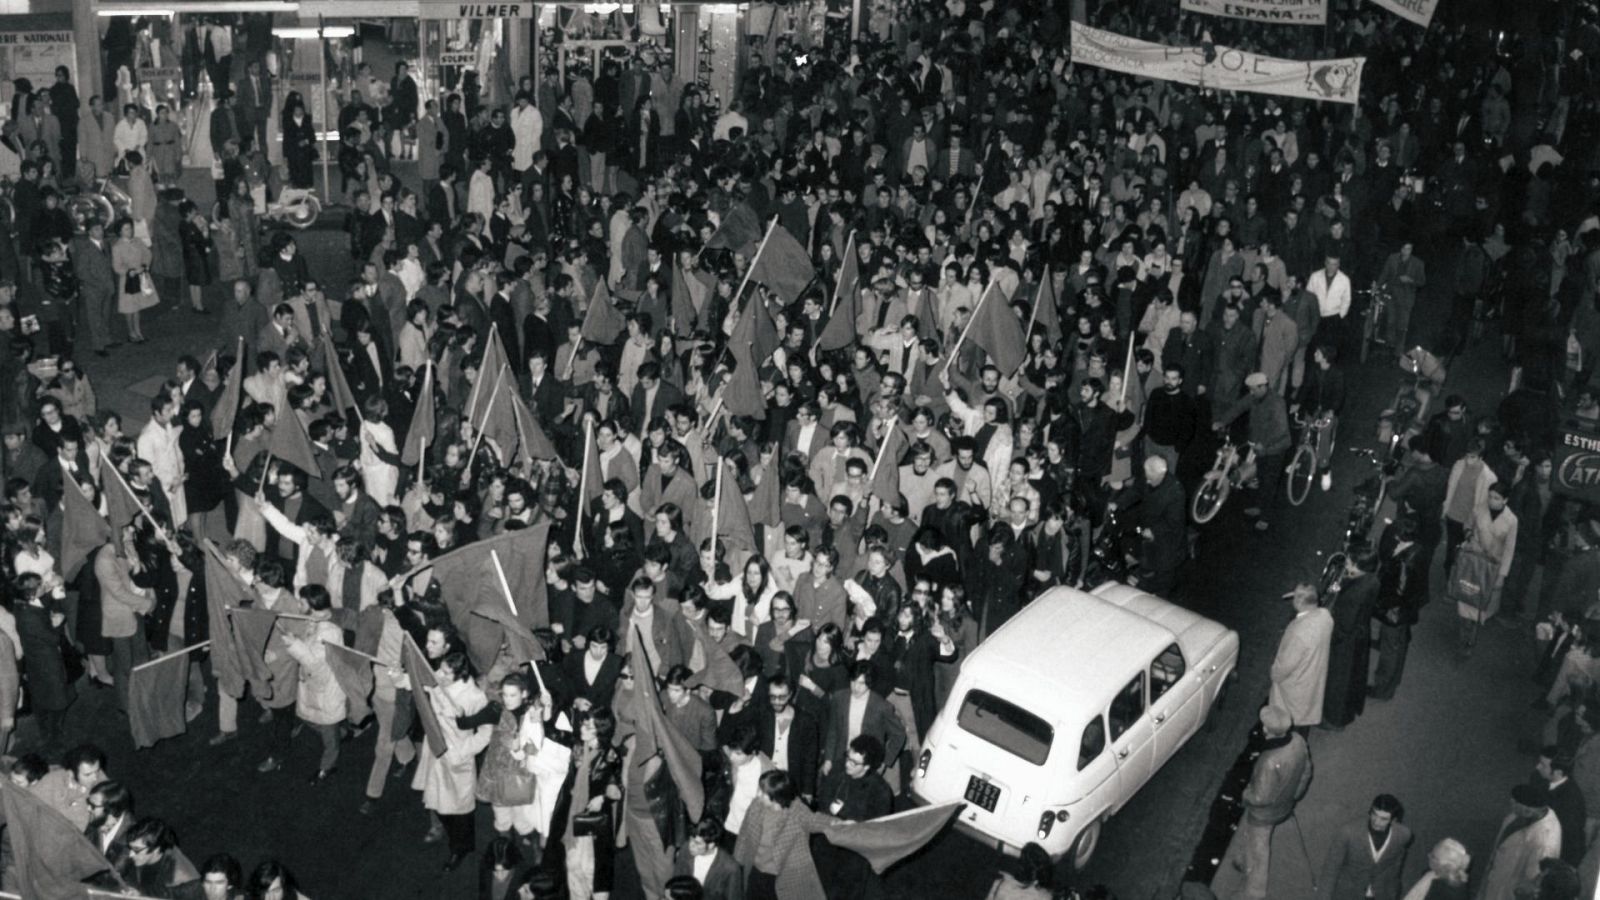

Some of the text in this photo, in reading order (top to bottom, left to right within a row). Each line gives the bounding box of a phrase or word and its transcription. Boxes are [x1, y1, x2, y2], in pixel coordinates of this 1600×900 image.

[459, 4, 520, 17] VILMER
[1224, 3, 1293, 20] ESPAÑA
[23, 32, 70, 44] NATIONALE
[441, 54, 475, 63] SOLDES
